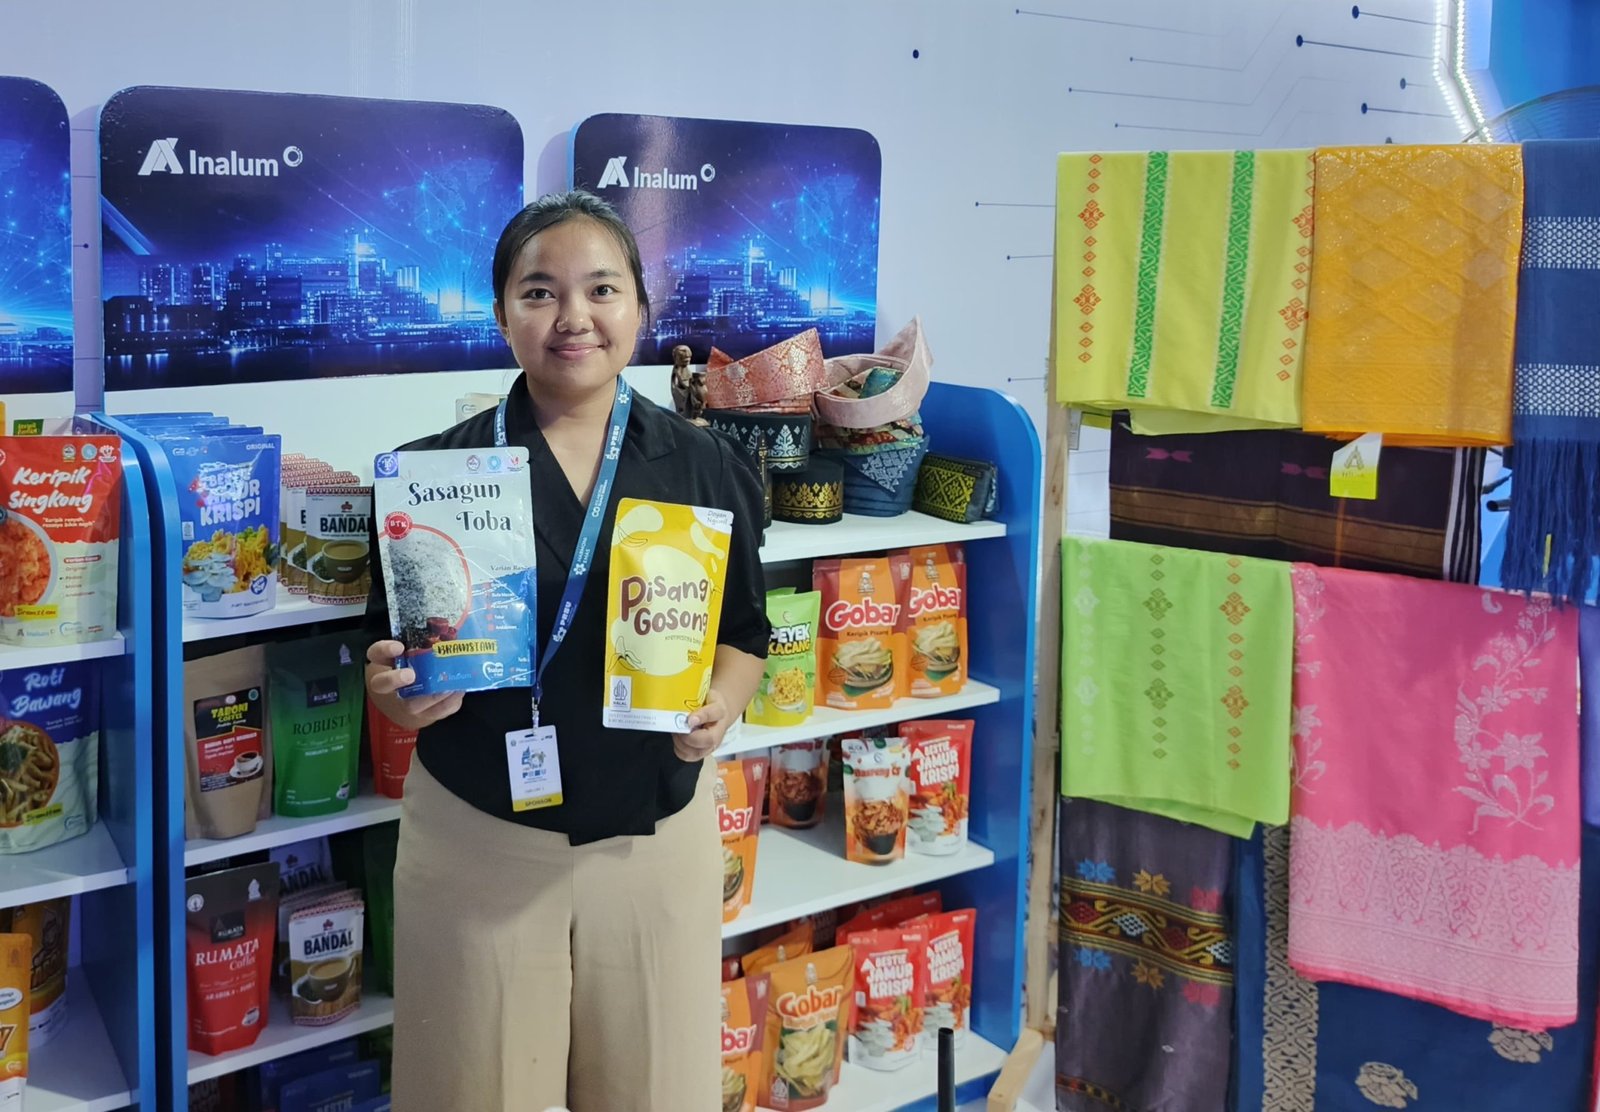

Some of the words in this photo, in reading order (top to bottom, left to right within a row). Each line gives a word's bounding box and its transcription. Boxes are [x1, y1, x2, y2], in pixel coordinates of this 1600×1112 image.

[190, 150, 279, 176] Inalum
[633, 166, 698, 190] Inalum
[12, 466, 92, 488] Keripik
[408, 482, 501, 506] Sasagun
[200, 497, 260, 526] KRISPI
[456, 510, 512, 531] Toba
[620, 575, 708, 622] Pisang
[634, 608, 708, 636] Gosong
[23, 667, 66, 691] Roti
[10, 687, 82, 718] Bawang
[916, 749, 958, 772] JAMUR
[920, 764, 960, 787] KRISPI
[525, 797, 552, 807] SPONSOR
[717, 804, 753, 835] bar
[279, 864, 326, 893] ANDAL
[195, 938, 260, 967] RUMATA
[304, 931, 353, 955] BANDAL
[866, 962, 914, 984] JAMUR
[869, 976, 914, 999] KRISPI
[777, 985, 844, 1019] Gobar
[722, 1022, 757, 1056] bar
